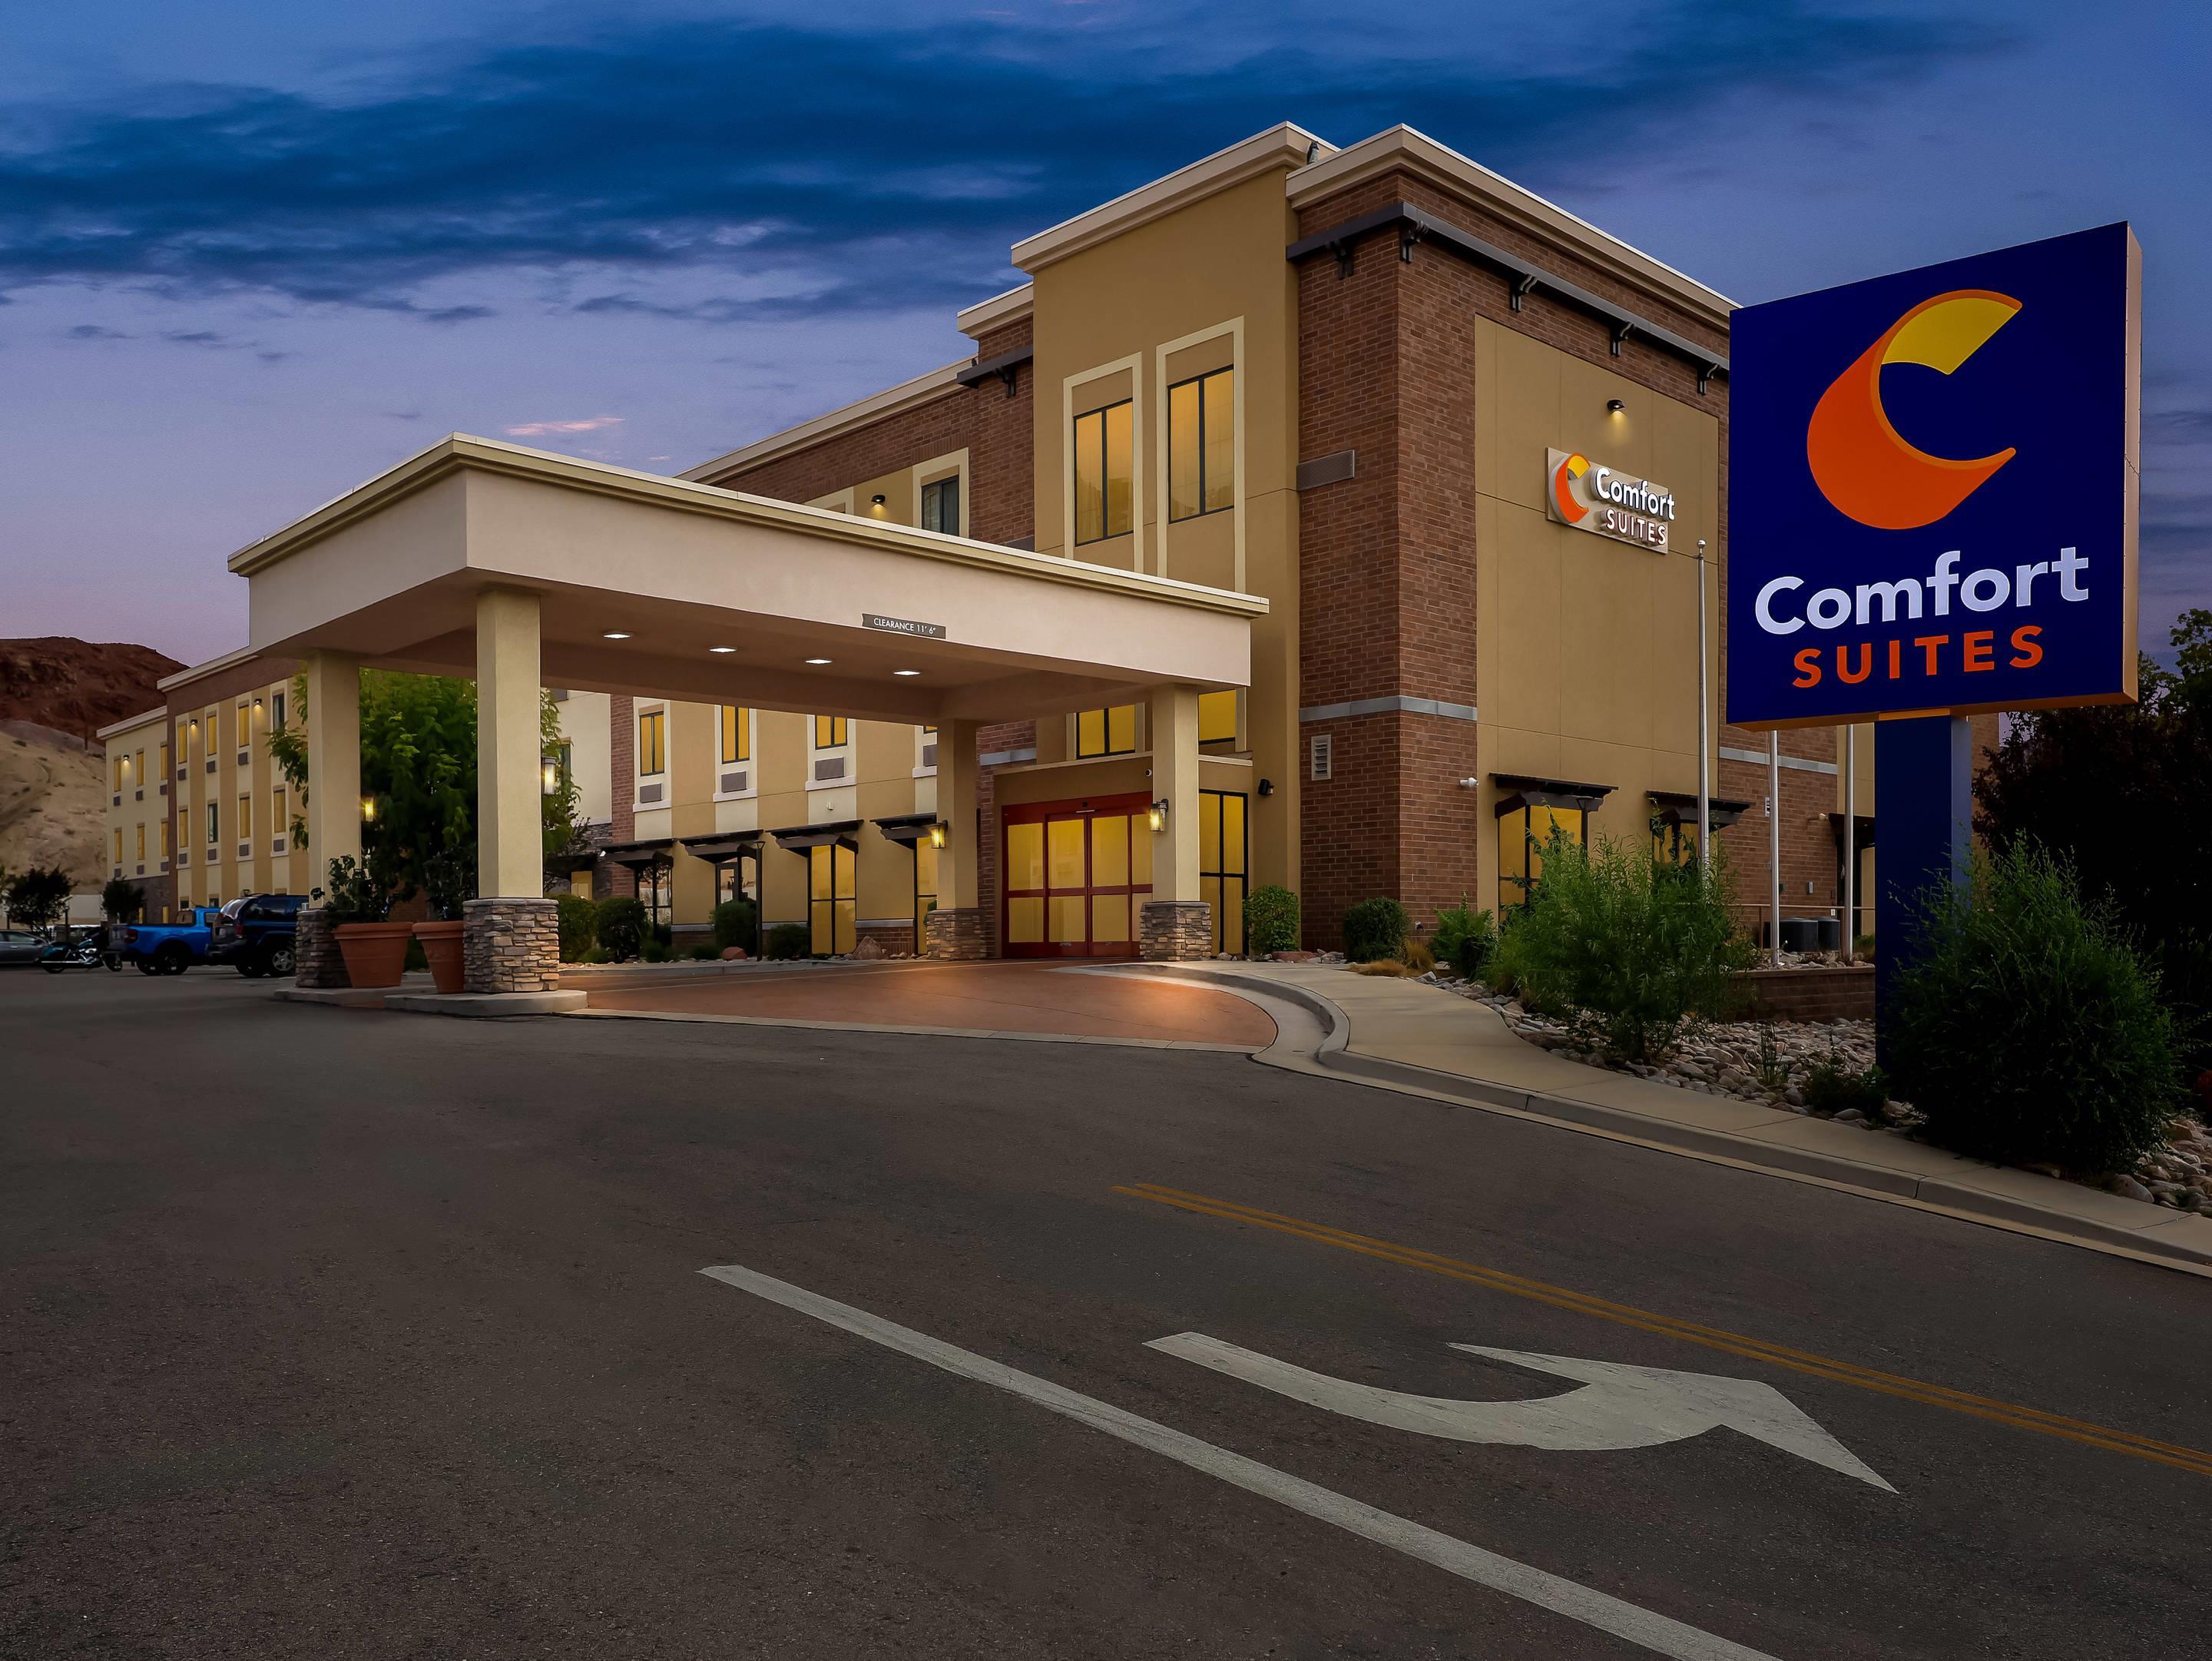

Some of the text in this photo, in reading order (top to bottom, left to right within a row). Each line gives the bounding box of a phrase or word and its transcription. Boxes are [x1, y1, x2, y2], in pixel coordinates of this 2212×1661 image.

[1595, 466, 1675, 521] Comfort
[1606, 508, 1667, 545] SUITES
[1754, 546, 2089, 635] Comfort
[873, 618, 915, 632] CLEARANCE
[1792, 625, 2044, 688] SUITES
